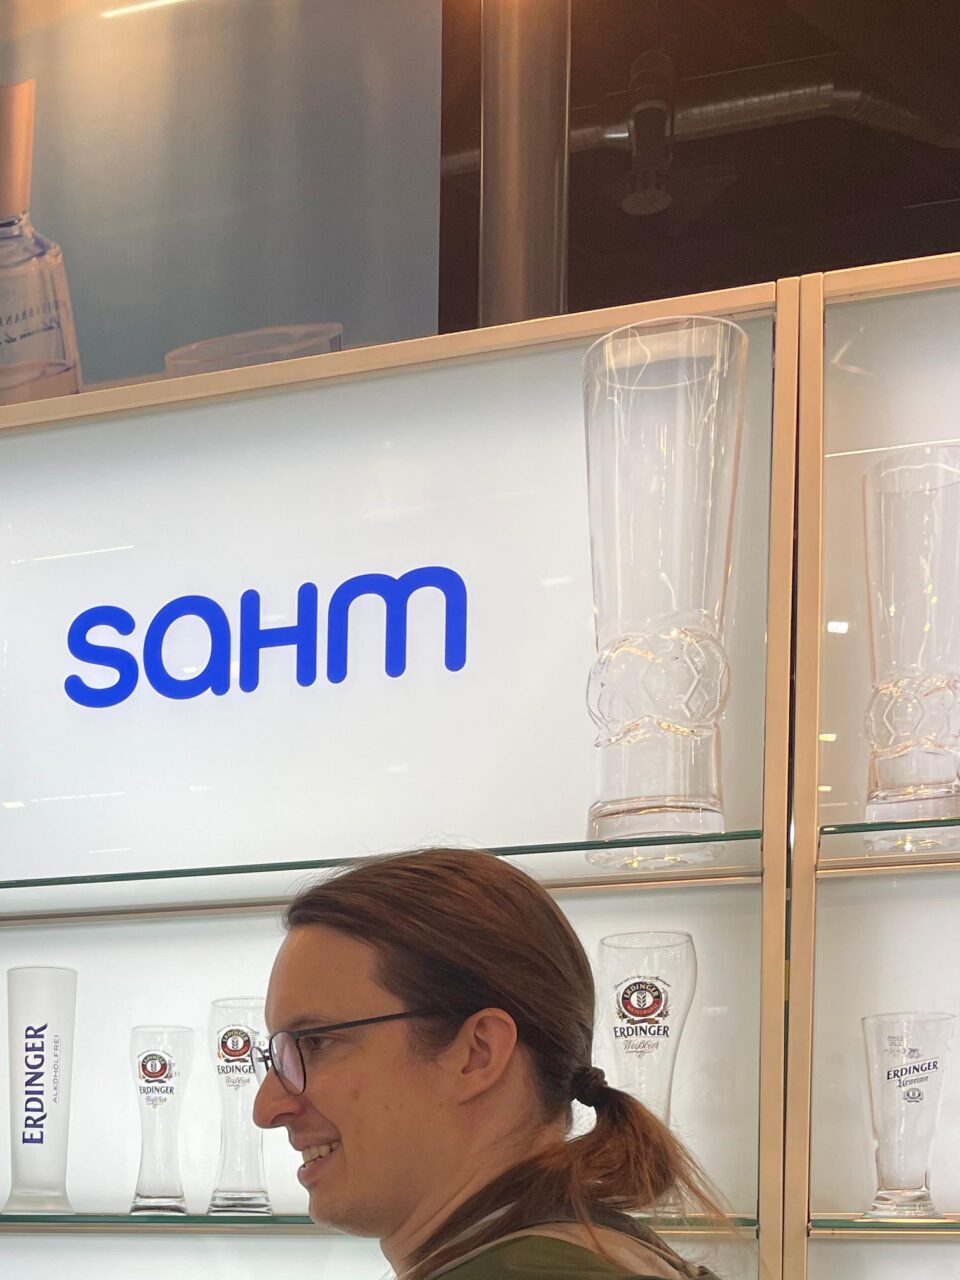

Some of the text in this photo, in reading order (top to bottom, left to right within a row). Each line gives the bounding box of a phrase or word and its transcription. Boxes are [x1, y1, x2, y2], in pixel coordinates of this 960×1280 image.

[613, 1025, 670, 1039] ERDINGER
[217, 1065, 256, 1074] ERDINGE
[887, 1061, 938, 1080] ERDINGER
[22, 1023, 48, 1145] ERDINGER
[139, 1086, 174, 1095] ERDINGER
